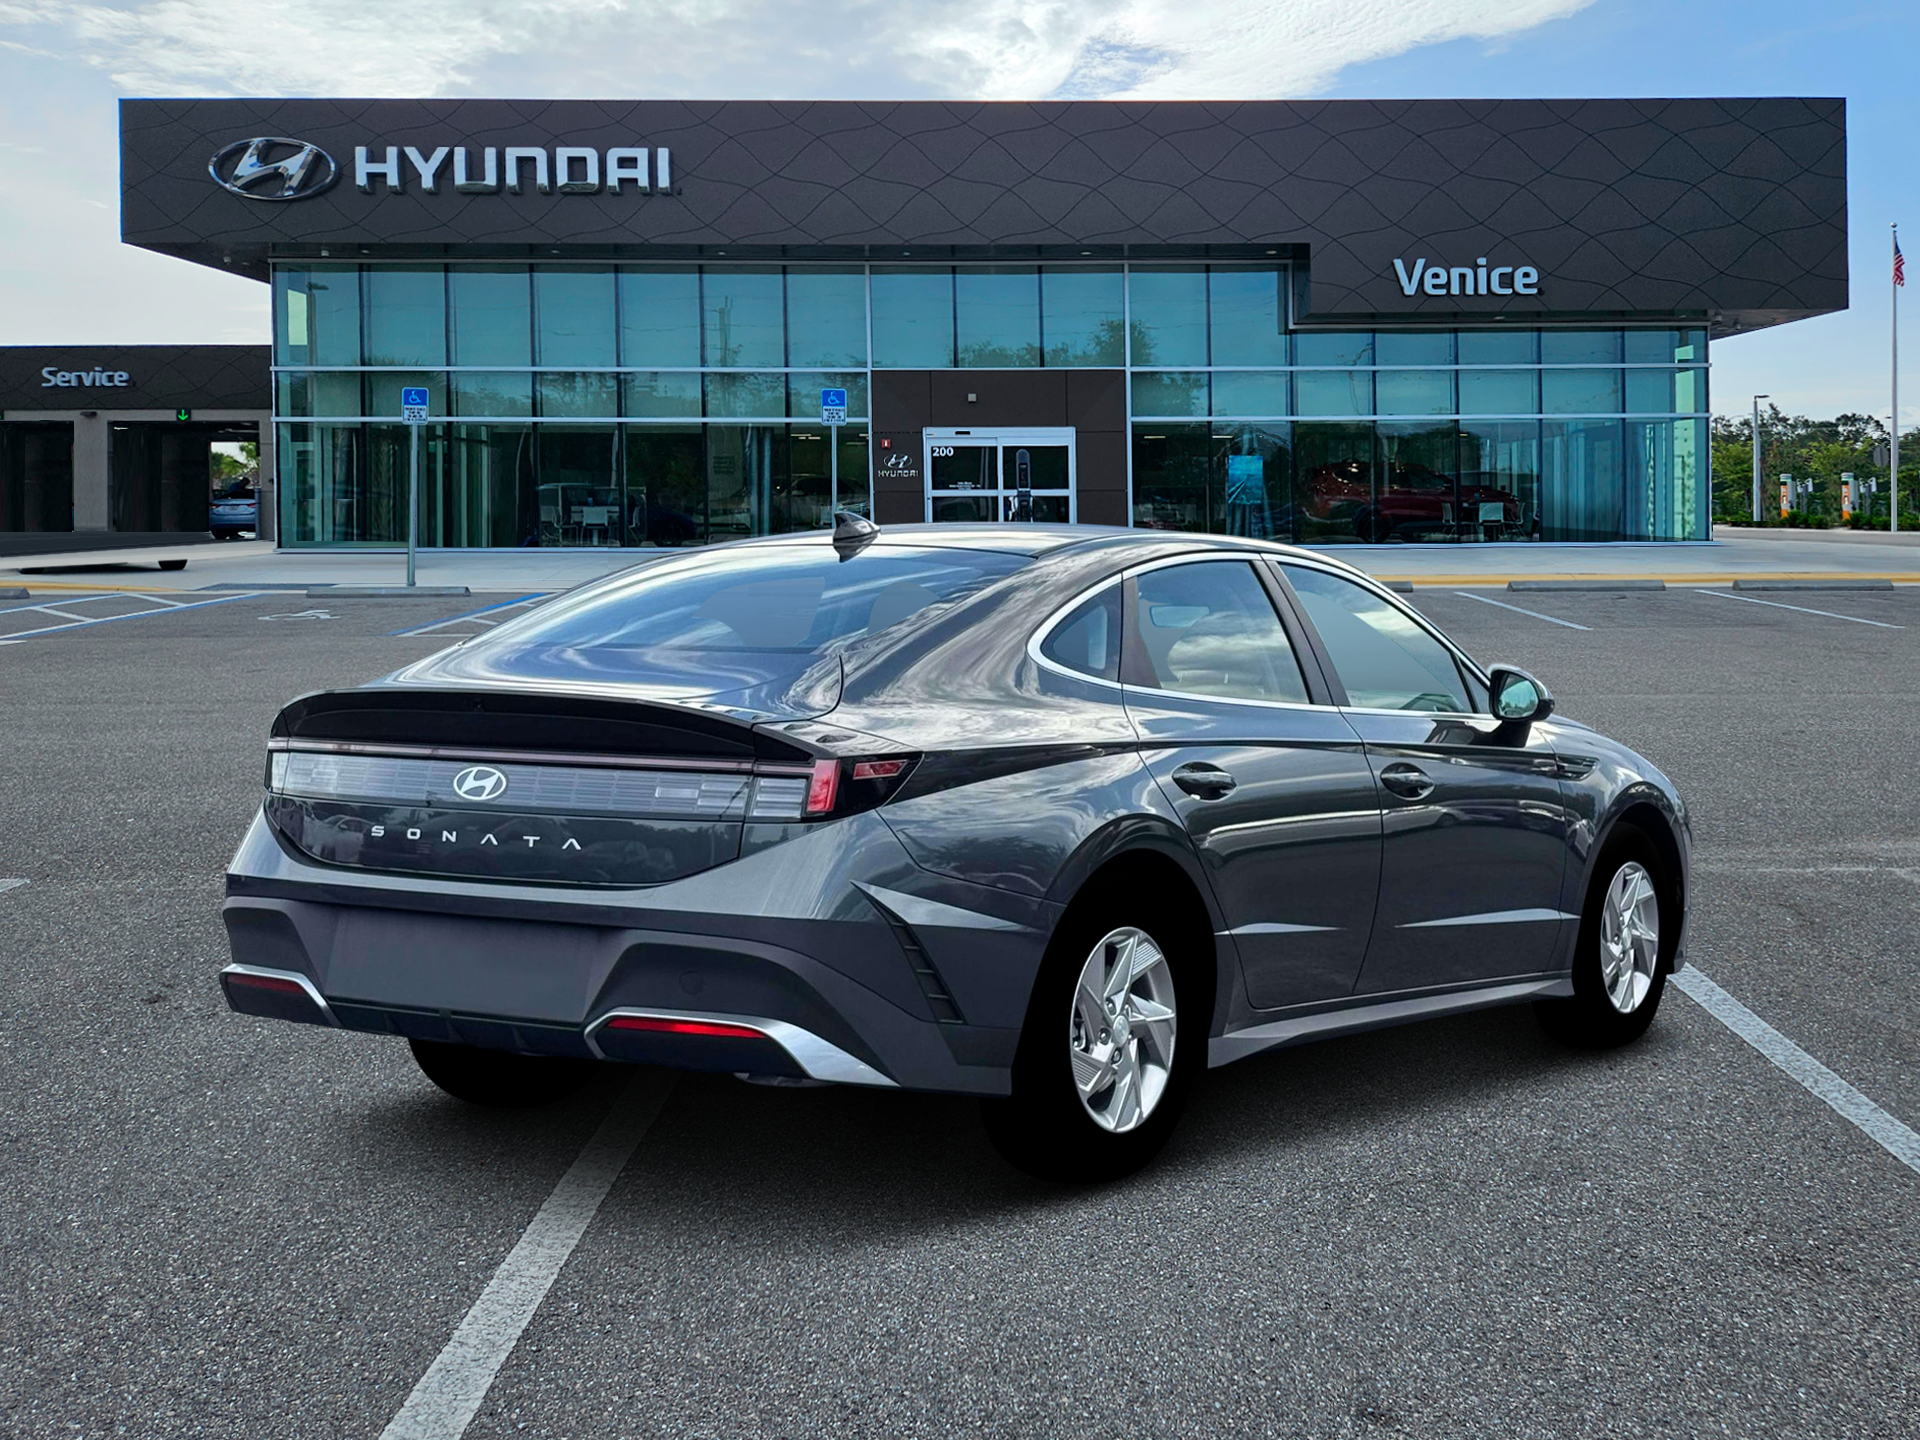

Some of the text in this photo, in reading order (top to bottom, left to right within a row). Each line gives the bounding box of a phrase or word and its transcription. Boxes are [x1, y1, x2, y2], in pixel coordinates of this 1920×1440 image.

[355, 146, 670, 194] HYUNDAI
[1393, 257, 1539, 296] Venice
[41, 366, 130, 387] Service
[932, 447, 954, 457] 200
[878, 470, 919, 478] HYUNDAI
[371, 825, 582, 850] SONATA
